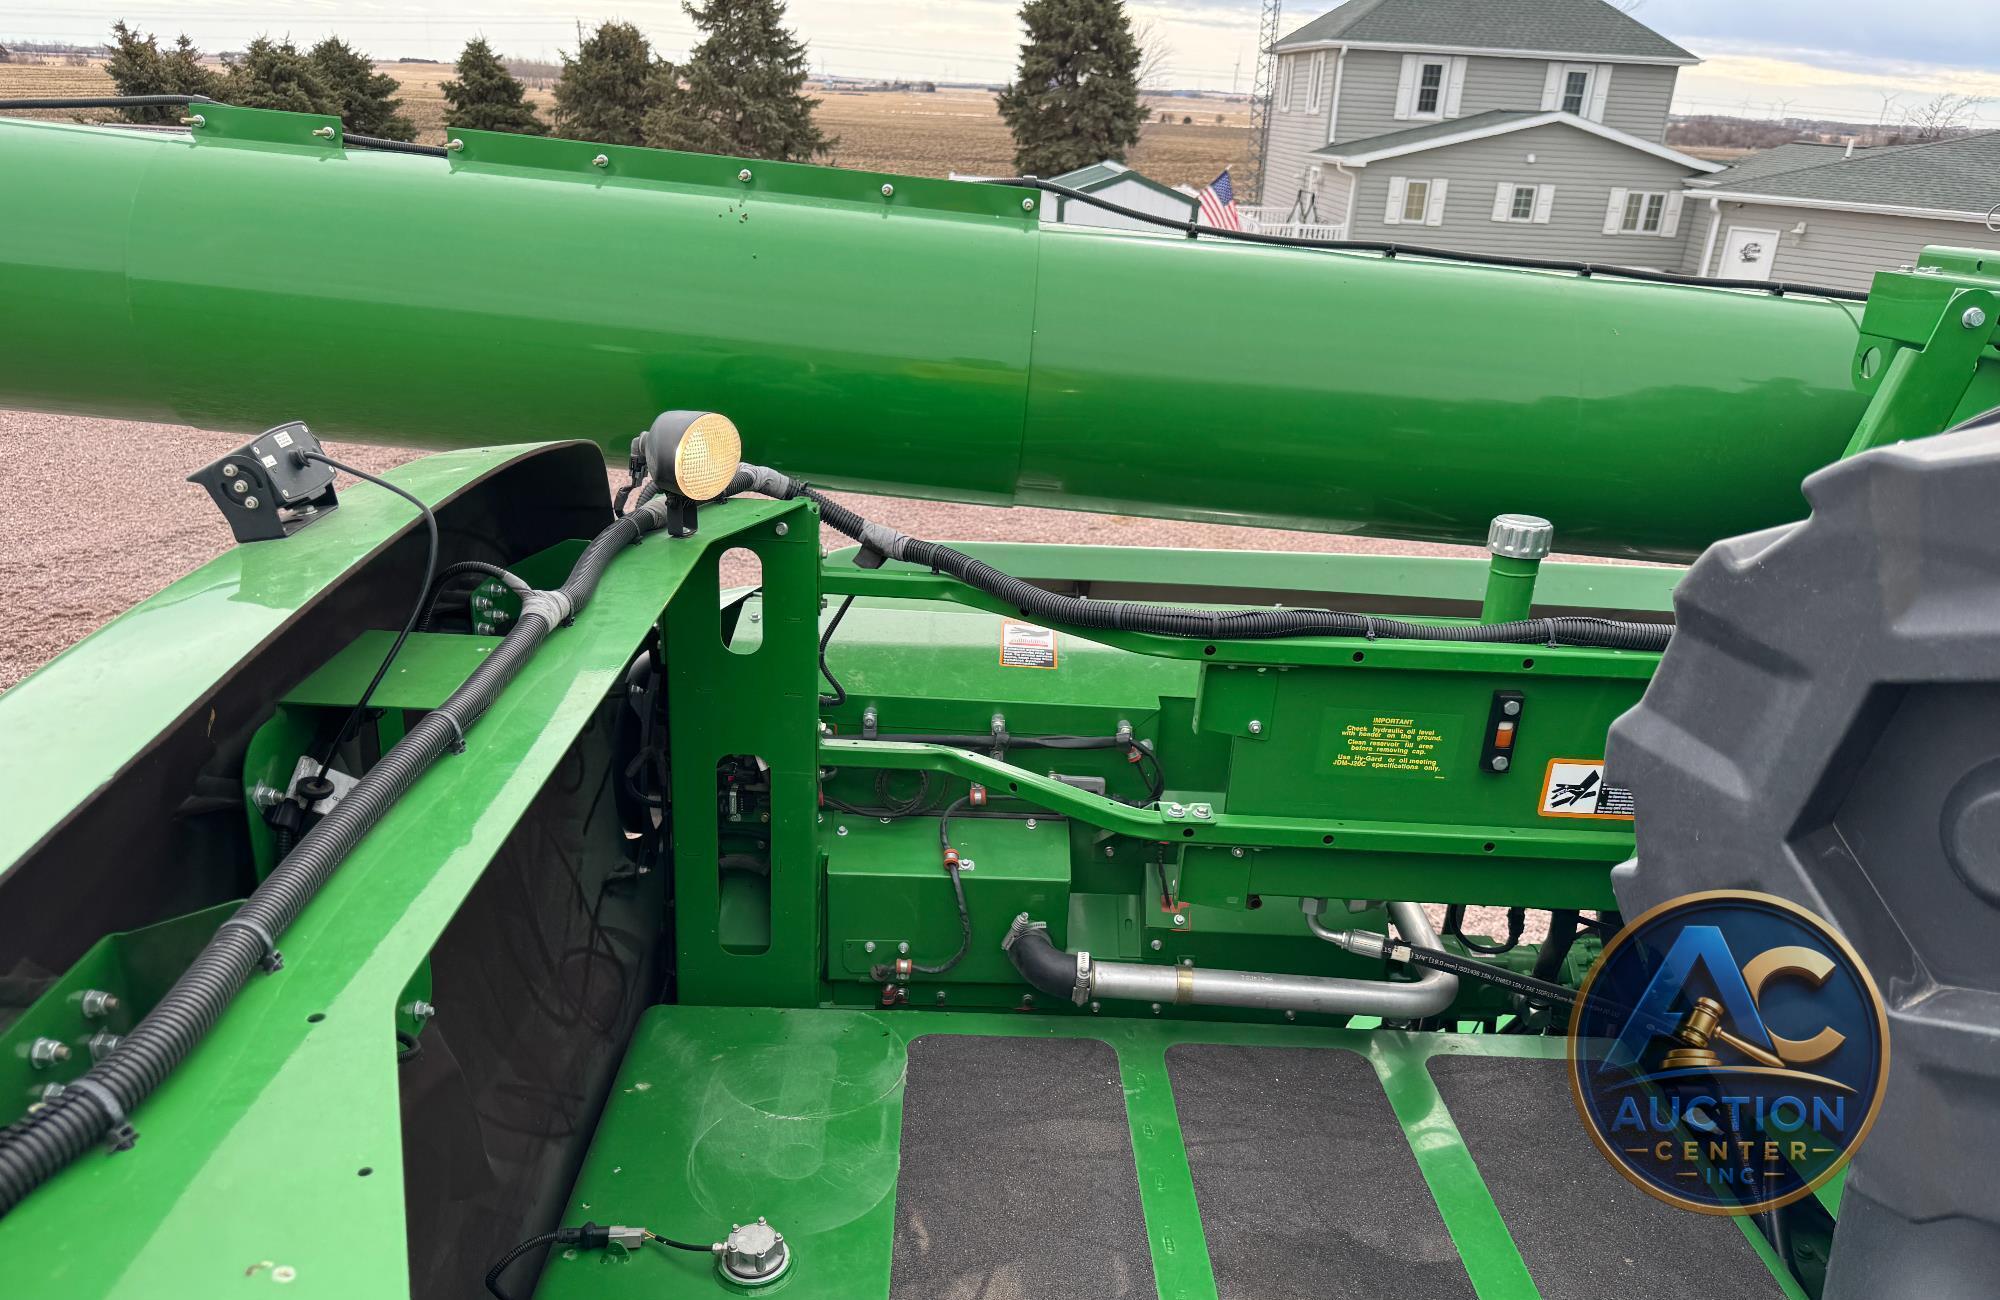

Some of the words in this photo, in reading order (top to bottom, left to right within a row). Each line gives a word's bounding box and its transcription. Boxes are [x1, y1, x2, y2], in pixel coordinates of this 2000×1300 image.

[1373, 717, 1414, 725] IMPORTANT
[1372, 726, 1404, 735] hydraulic
[1347, 738, 1367, 746] Clean
[1376, 747, 1409, 755] removing
[1354, 755, 1383, 763] Hy-Gard
[1409, 759, 1437, 767] meeting
[1332, 759, 1367, 767] JDM-J20C
[1371, 762, 1419, 770] specifications
[1423, 765, 1441, 773] only.
